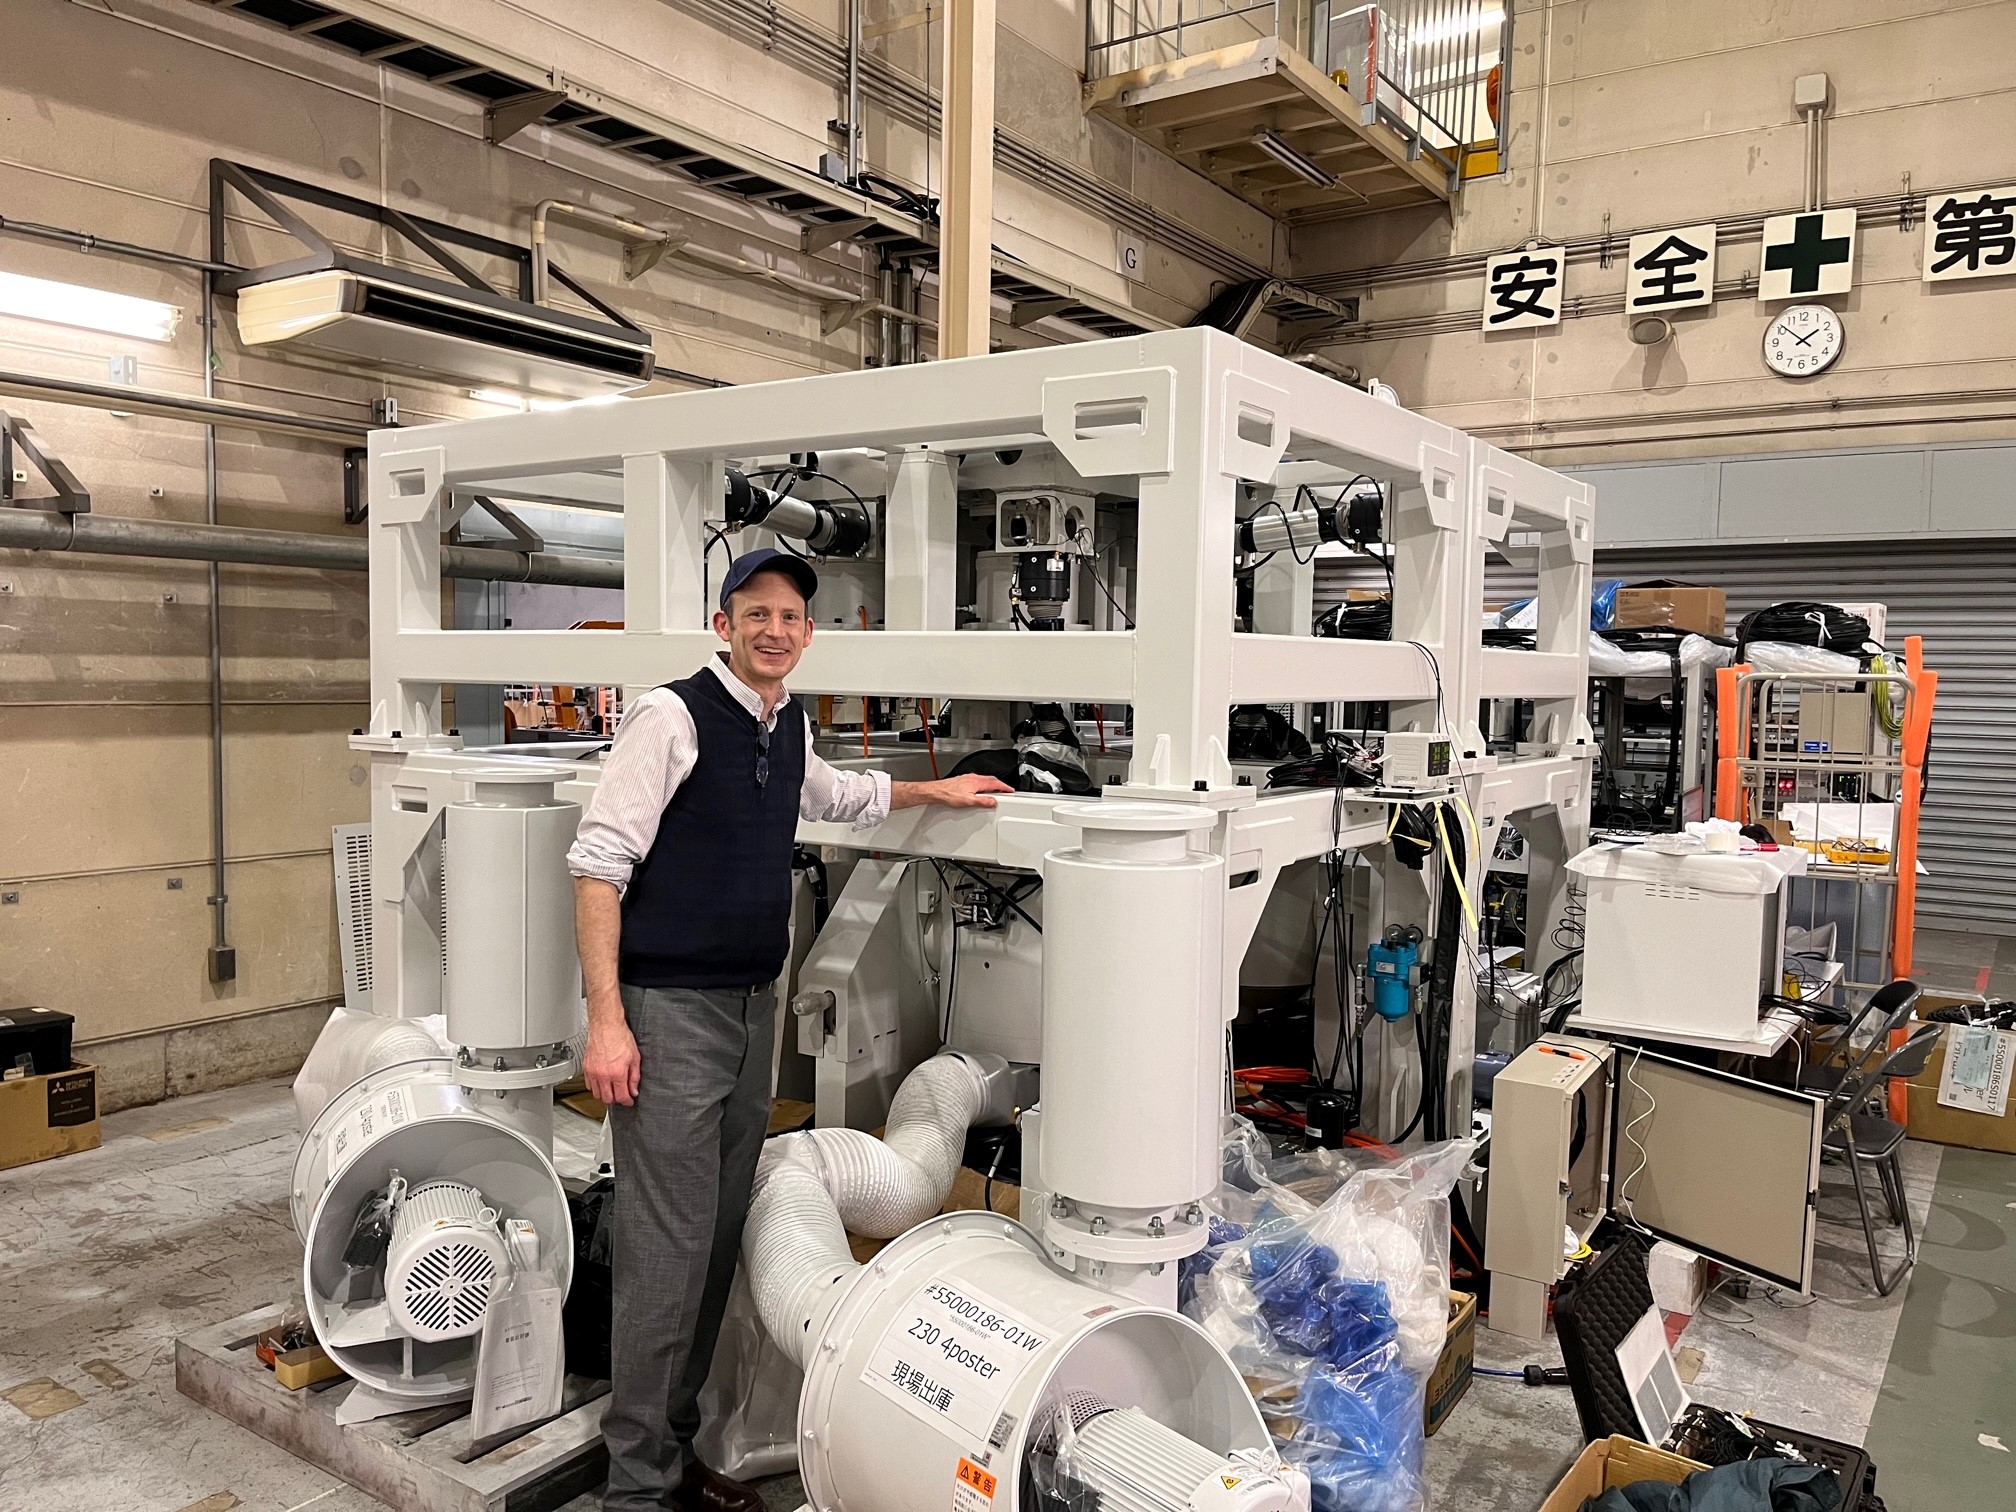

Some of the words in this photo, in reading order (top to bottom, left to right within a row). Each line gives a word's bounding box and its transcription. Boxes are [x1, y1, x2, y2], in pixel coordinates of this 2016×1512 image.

[1125, 247, 1137, 269] G
[1489, 255, 1558, 324] 安
[1633, 235, 1709, 307] 全
[1930, 194, 2016, 273] 第
[1787, 316, 1796, 326] 11
[1799, 311, 1809, 322] 12
[1777, 326, 1787, 336] 10
[1823, 321, 1831, 331] 2
[1772, 338, 1779, 348] 9
[1826, 333, 1834, 343] 3
[1776, 351, 1783, 361] 8
[1821, 347, 1829, 357] 4
[1786, 358, 1793, 368] 7
[1797, 360, 1805, 370] 6
[1811, 356, 1819, 366] 5
[924, 1283, 1043, 1352] #55000186-01W
[907, 1317, 941, 1345] 230
[940, 1337, 1001, 1380] 4poster
[891, 1359, 955, 1412] 現場出庫
